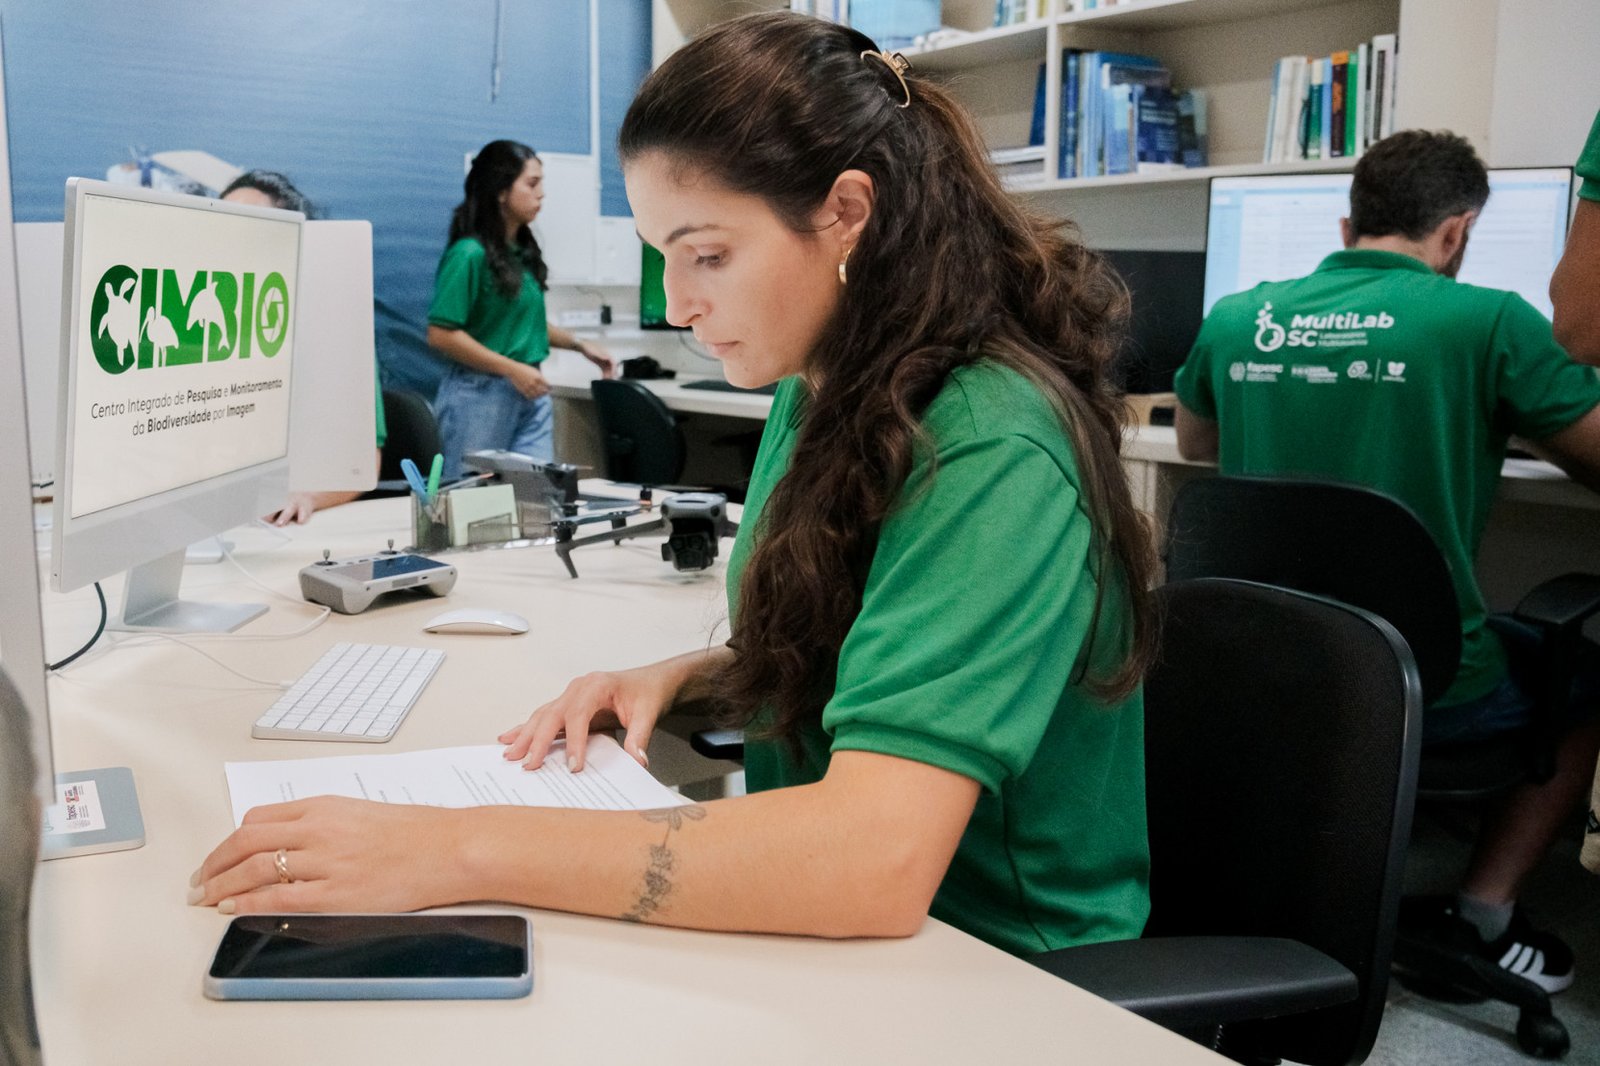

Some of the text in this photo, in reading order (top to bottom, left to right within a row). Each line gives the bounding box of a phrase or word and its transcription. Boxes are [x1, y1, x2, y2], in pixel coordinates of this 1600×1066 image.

[90, 264, 289, 375] CIMBIO
[1290, 311, 1395, 330] MultiLab
[1286, 330, 1319, 347] SC
[91, 378, 283, 419] Centro Integrado de Pesquisa e Monitoramento
[132, 402, 256, 436] da Biodiversidade por Imagem
